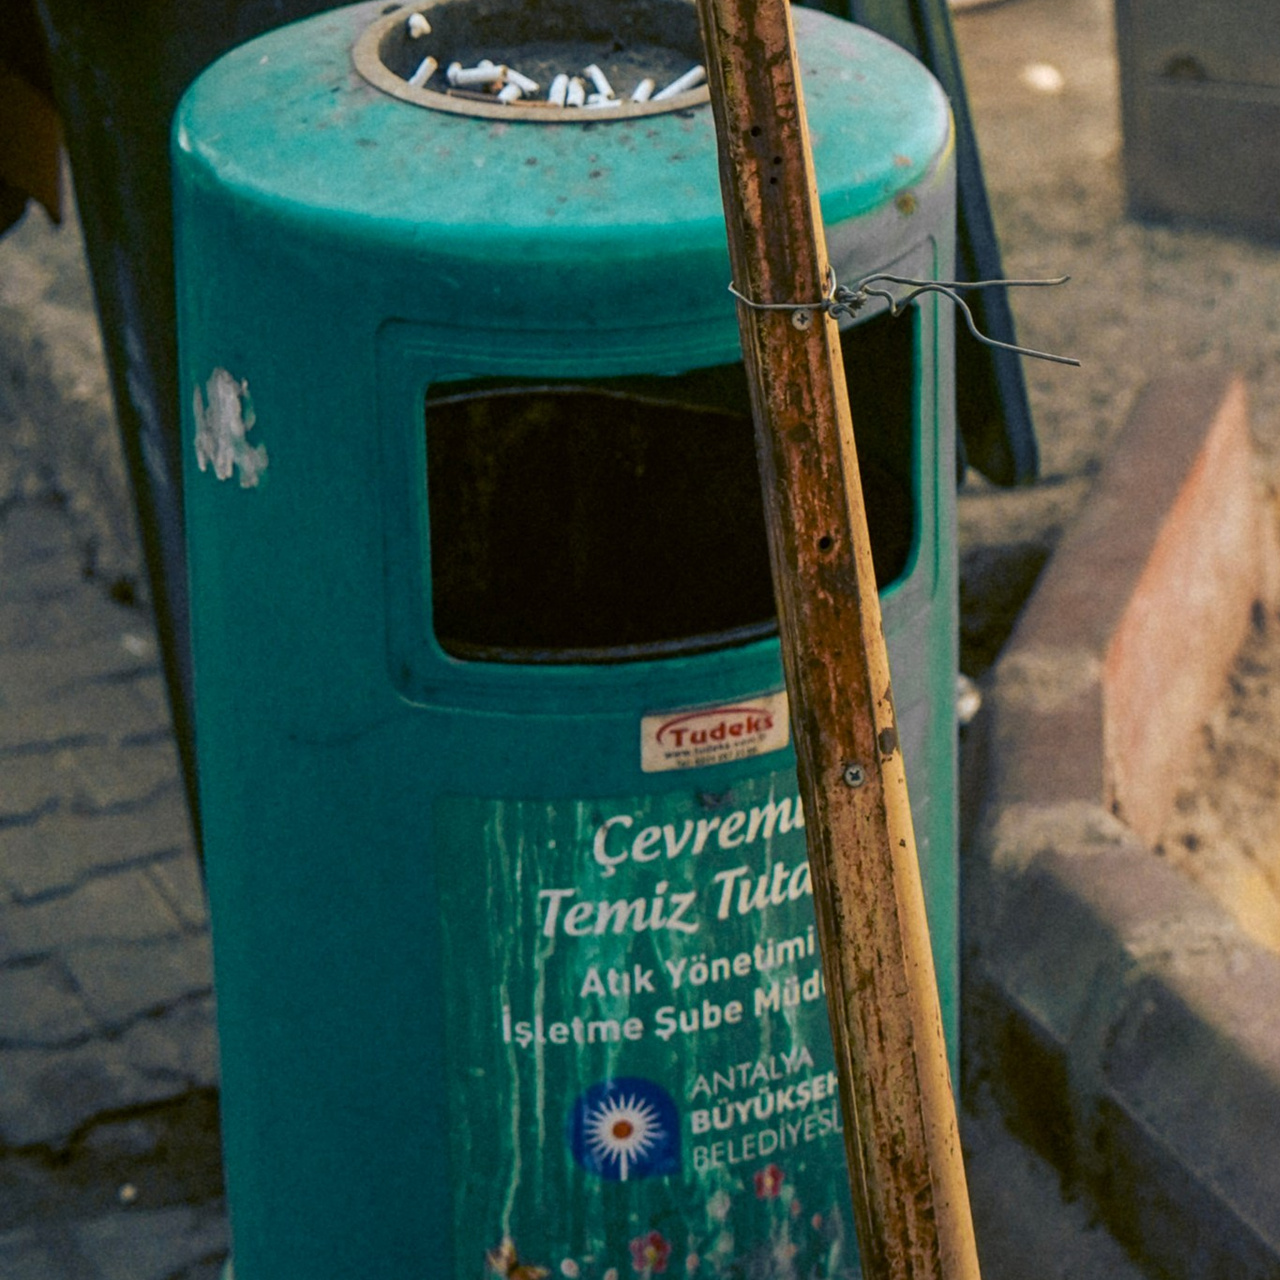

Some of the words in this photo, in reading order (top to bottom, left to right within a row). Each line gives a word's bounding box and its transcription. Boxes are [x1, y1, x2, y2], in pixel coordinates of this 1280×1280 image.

[669, 715, 774, 748] Tudeks
[538, 881, 700, 937] Temiz
[580, 964, 655, 998] Atık
[665, 926, 814, 989] Yönetimi
[654, 1000, 743, 1041] Şube
[754, 970, 826, 1017] Müd
[690, 1045, 814, 1101] ANTALYA
